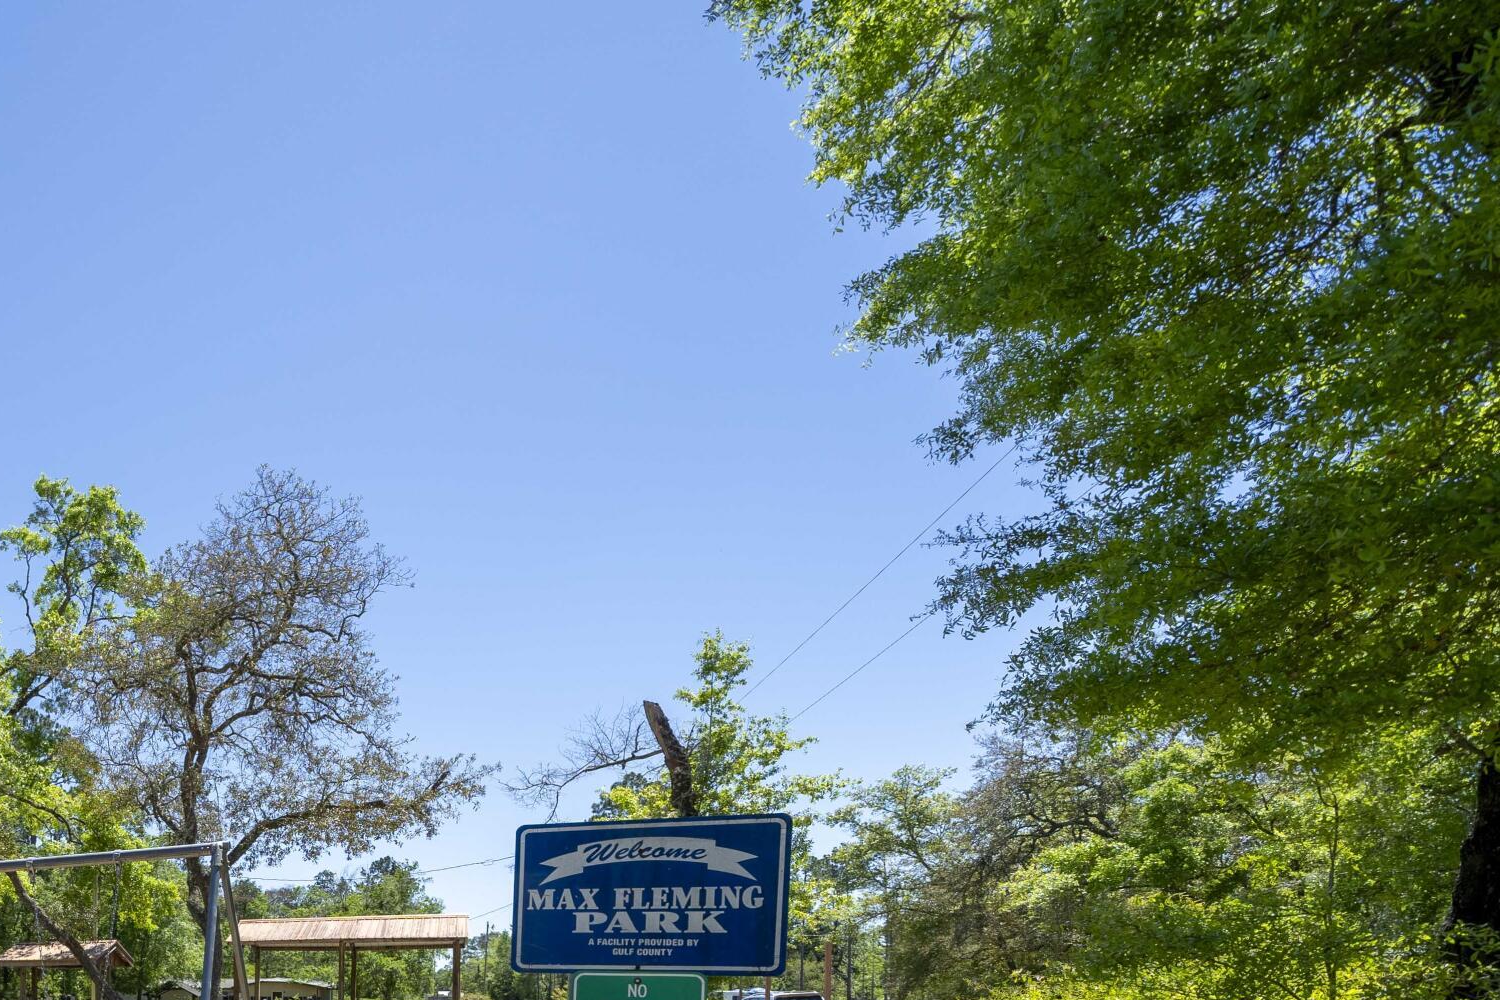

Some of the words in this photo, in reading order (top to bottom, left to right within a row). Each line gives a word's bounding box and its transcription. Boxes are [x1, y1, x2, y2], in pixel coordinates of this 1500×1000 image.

[583, 840, 708, 863] Welcome
[527, 888, 600, 910] MAX
[613, 885, 765, 910] FLEMING
[572, 910, 728, 934] PARK
[597, 938, 636, 946] FACILITY
[638, 938, 684, 946] PROVIDED
[686, 939, 699, 947] BY
[612, 948, 634, 956] GULF
[637, 948, 673, 956] COUNTY
[627, 984, 647, 998] NO
